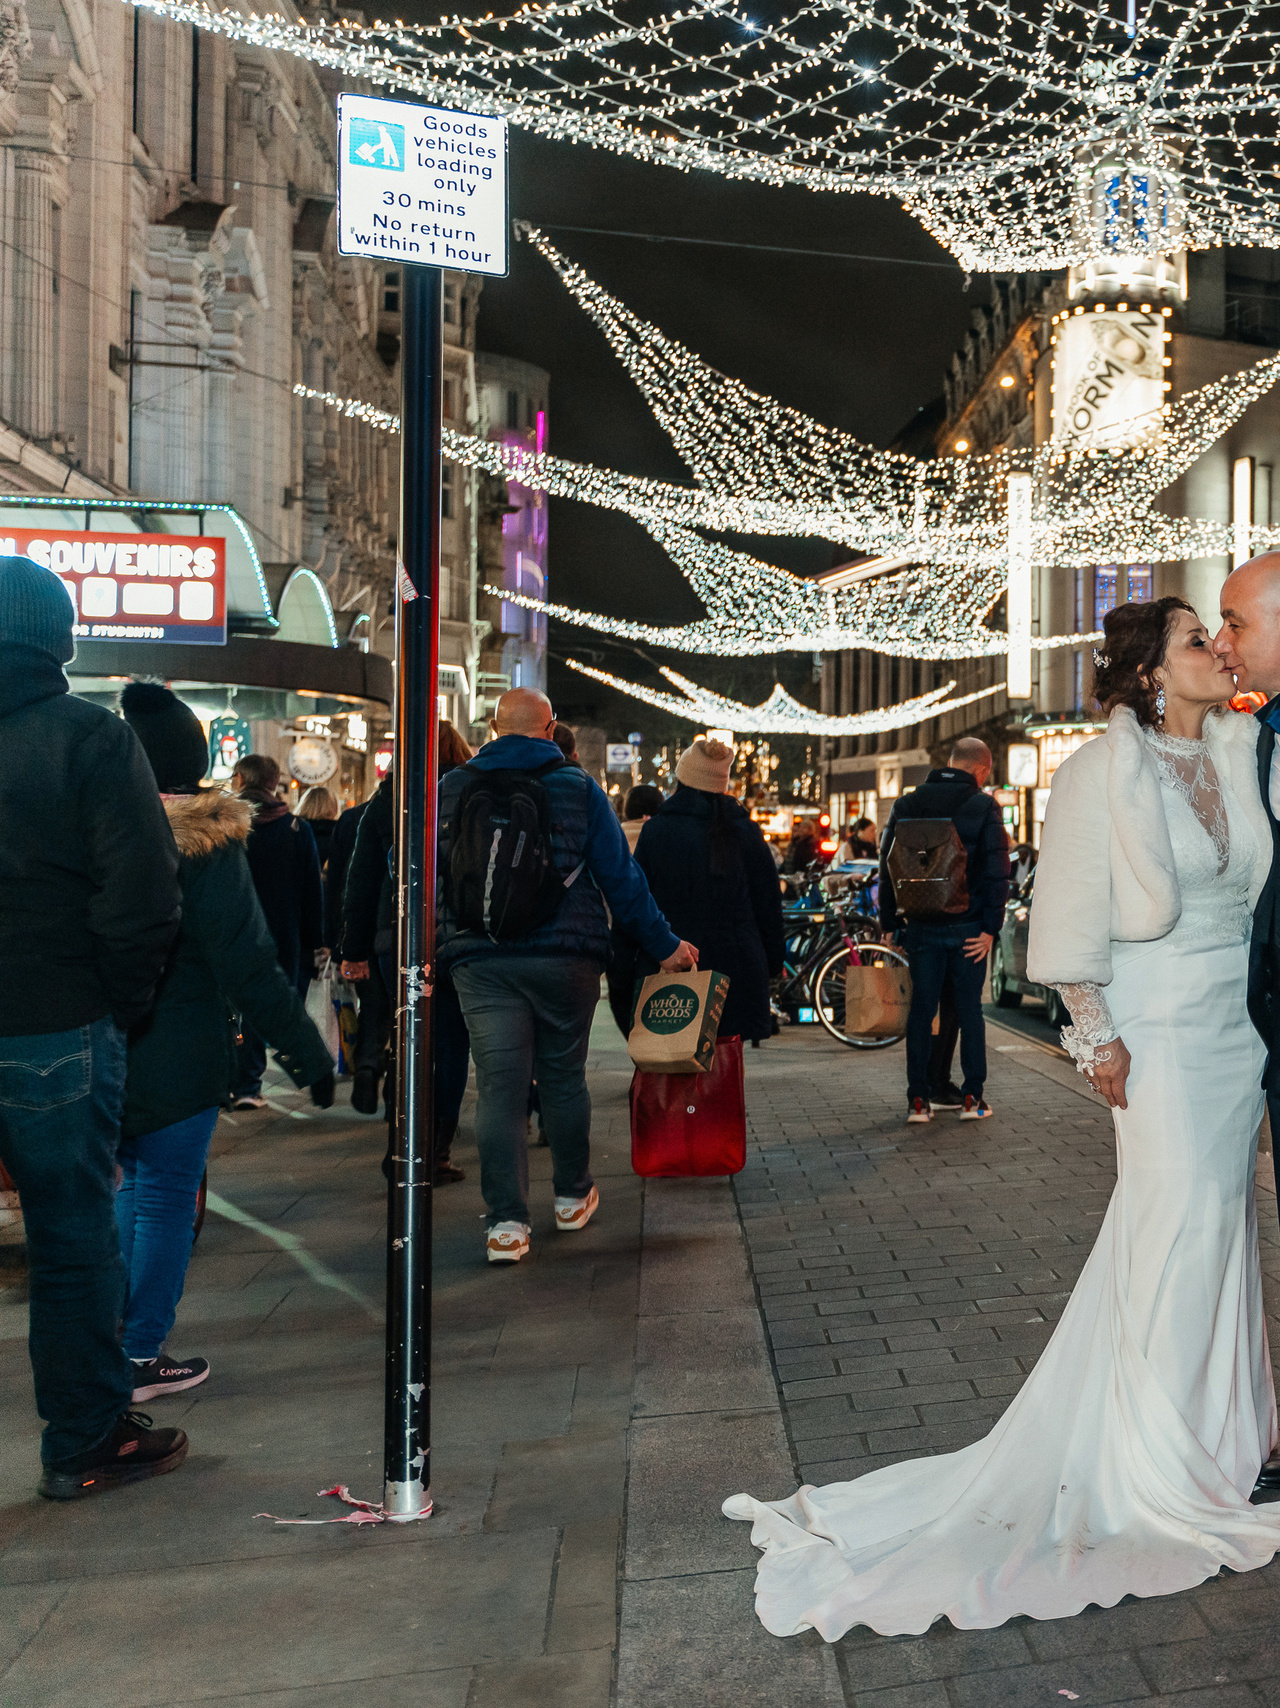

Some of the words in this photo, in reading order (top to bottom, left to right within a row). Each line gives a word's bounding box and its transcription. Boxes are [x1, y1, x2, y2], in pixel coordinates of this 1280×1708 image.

[423, 115, 488, 139] Goods
[413, 136, 497, 159] vehicles
[417, 152, 493, 180] loading
[433, 177, 477, 197] only
[382, 190, 412, 208] 30
[418, 199, 466, 217] mins
[372, 213, 402, 231] No
[410, 222, 476, 242] return
[354, 232, 420, 253] within
[429, 241, 436, 255] 1
[445, 244, 492, 264] hour
[1067, 376, 1090, 415] BOOK
[1087, 350, 1103, 372] OF
[26, 538, 217, 579] SOUVENIRS
[647, 1008, 692, 1019] FOODS
[650, 997, 696, 1009] WHOLE
